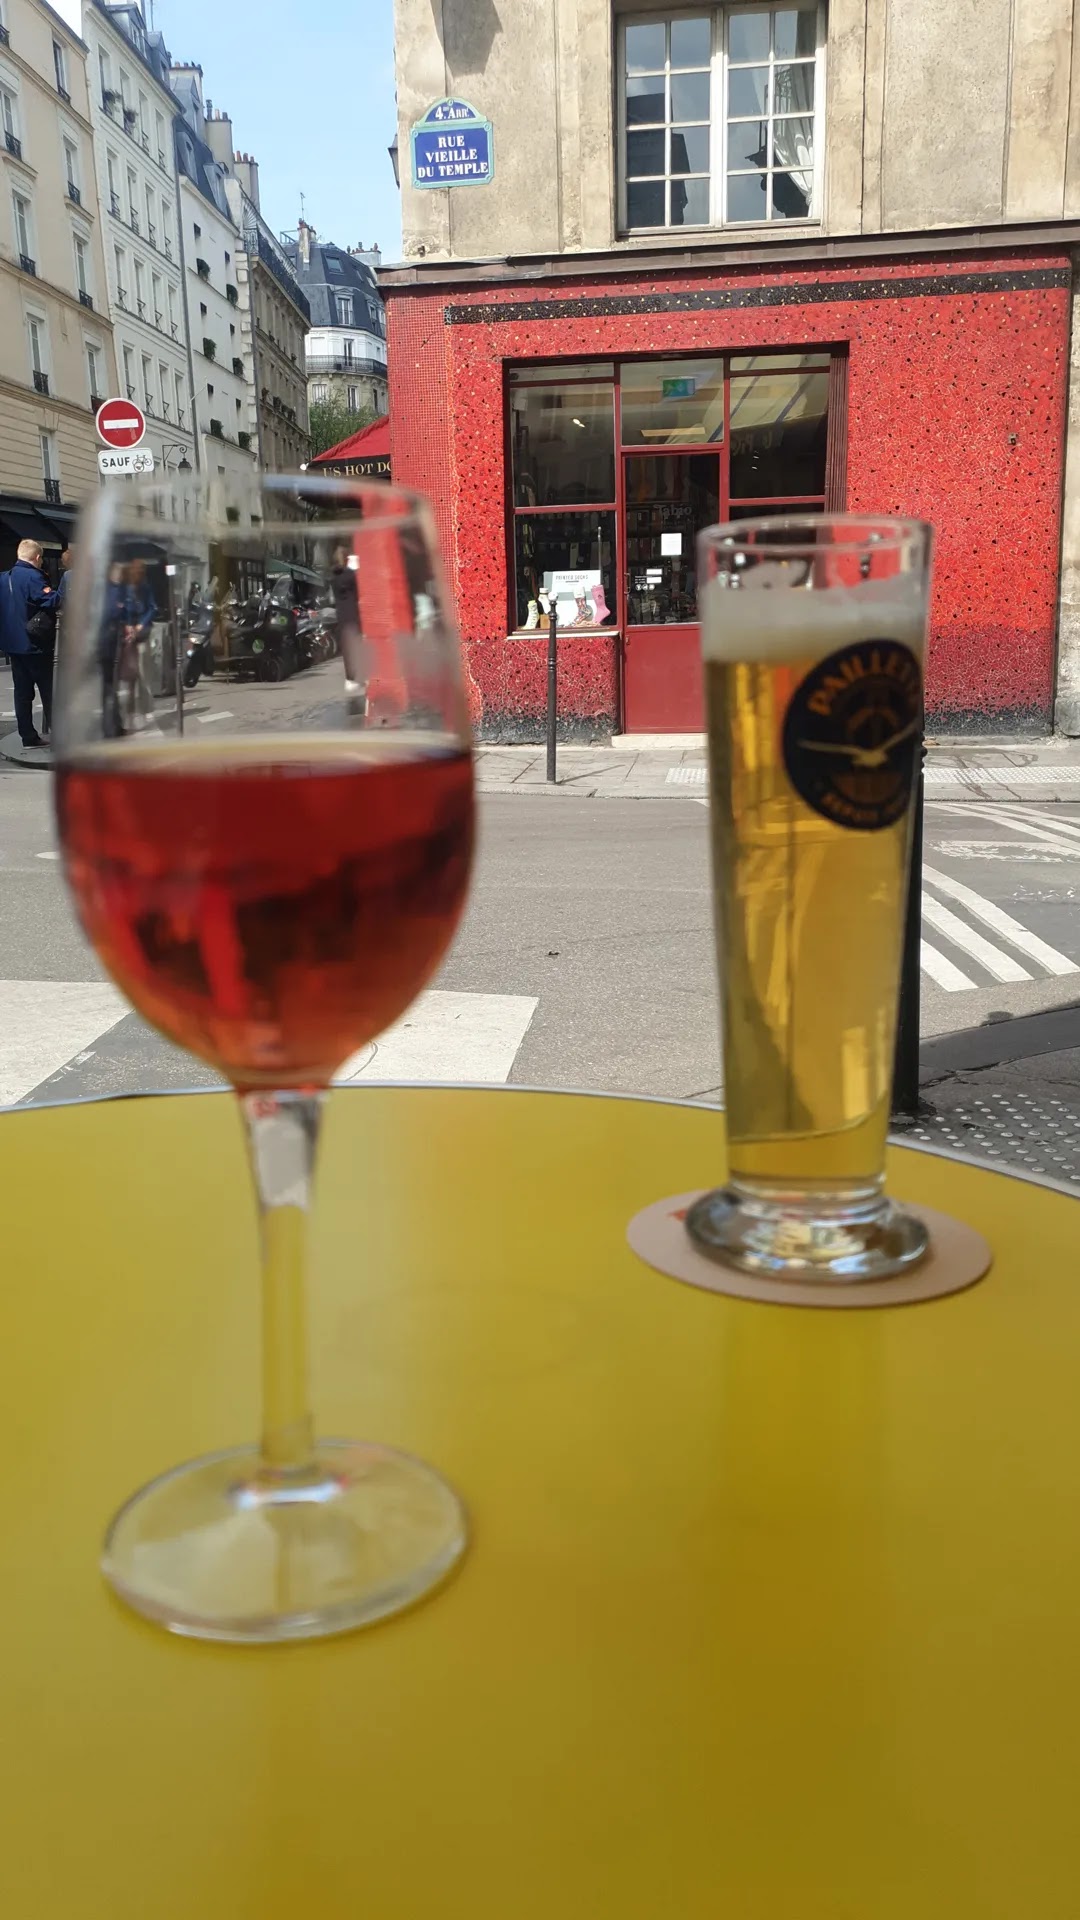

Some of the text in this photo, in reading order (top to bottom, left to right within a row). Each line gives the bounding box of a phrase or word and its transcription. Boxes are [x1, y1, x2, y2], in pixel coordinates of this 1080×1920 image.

[438, 135, 464, 148] RUE
[425, 149, 478, 163] VIEILLE
[417, 163, 488, 178] DU TEMPLE
[102, 456, 130, 468] SAUF
[344, 463, 373, 476] HOT
